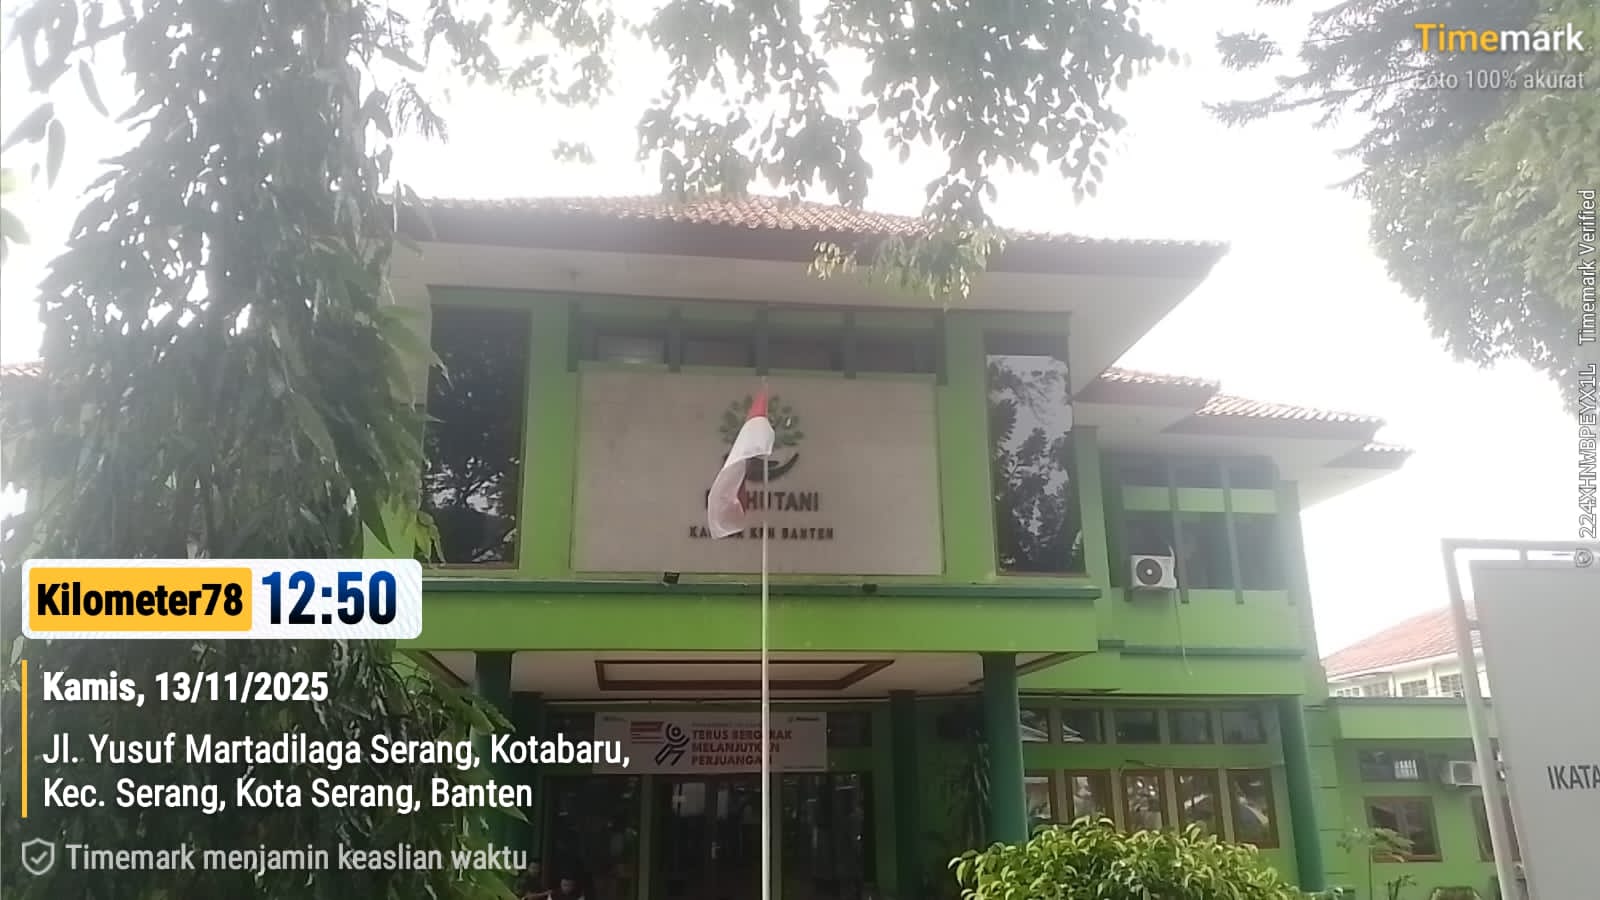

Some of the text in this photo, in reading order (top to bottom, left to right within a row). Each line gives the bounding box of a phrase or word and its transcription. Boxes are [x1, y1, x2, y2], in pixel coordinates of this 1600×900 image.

[705, 489, 819, 512] HUTANI
[692, 729, 792, 741] TERUS BERGRAK
[691, 742, 780, 753] MELANJUTKN
